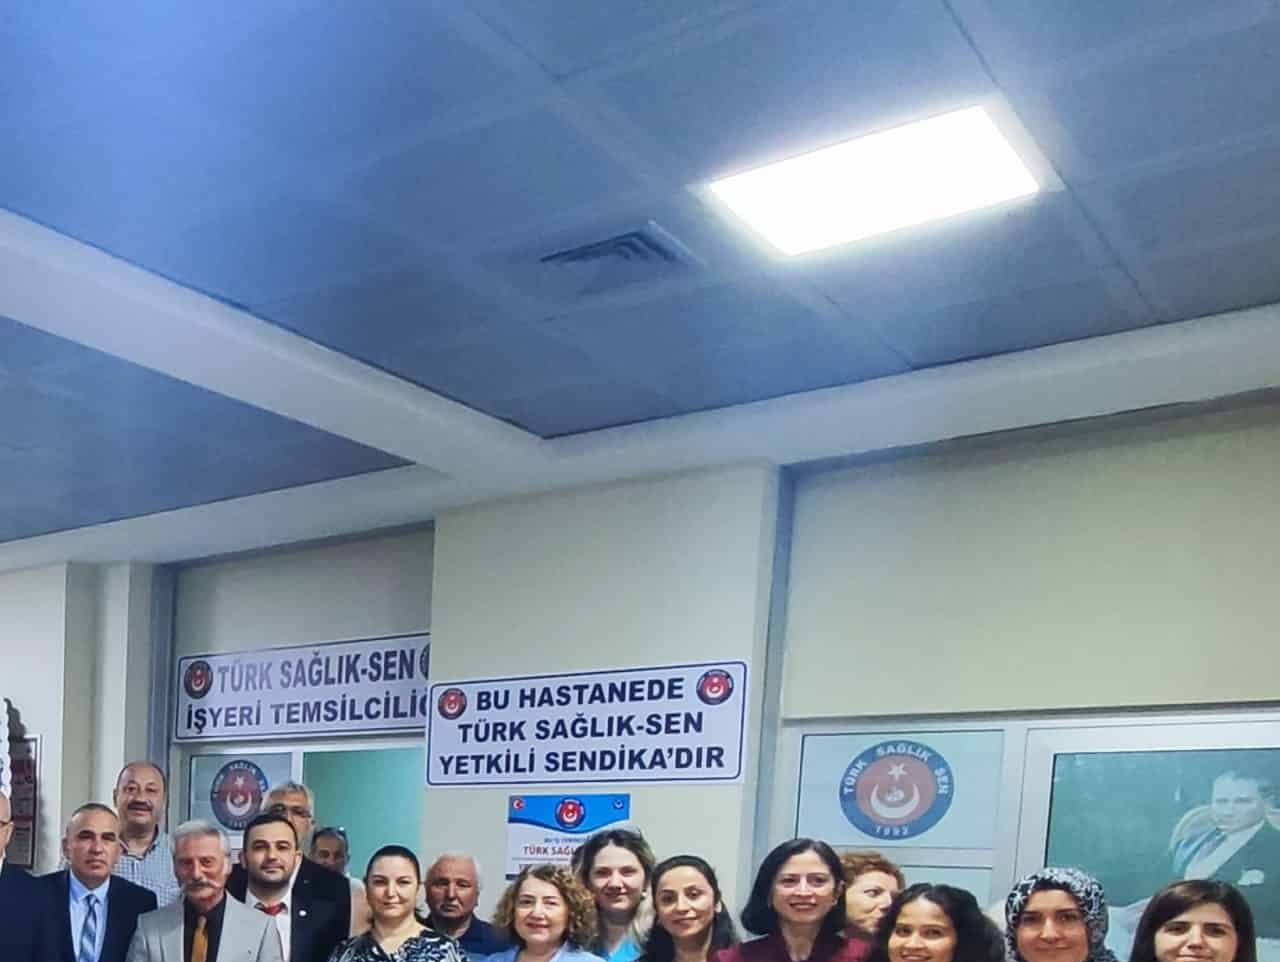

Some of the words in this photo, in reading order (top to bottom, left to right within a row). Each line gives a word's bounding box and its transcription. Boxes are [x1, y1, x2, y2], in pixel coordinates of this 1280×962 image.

[218, 660, 273, 693] TÜRK
[280, 649, 415, 688] SAĞLIK-SEN
[476, 689, 509, 711] BU
[519, 677, 684, 709] HASTANEDE
[186, 699, 262, 734] İŞYERİ
[458, 718, 526, 743] TÜRK
[535, 711, 703, 740] SAĞLIK-SEN
[439, 748, 535, 775] YETKİLİ
